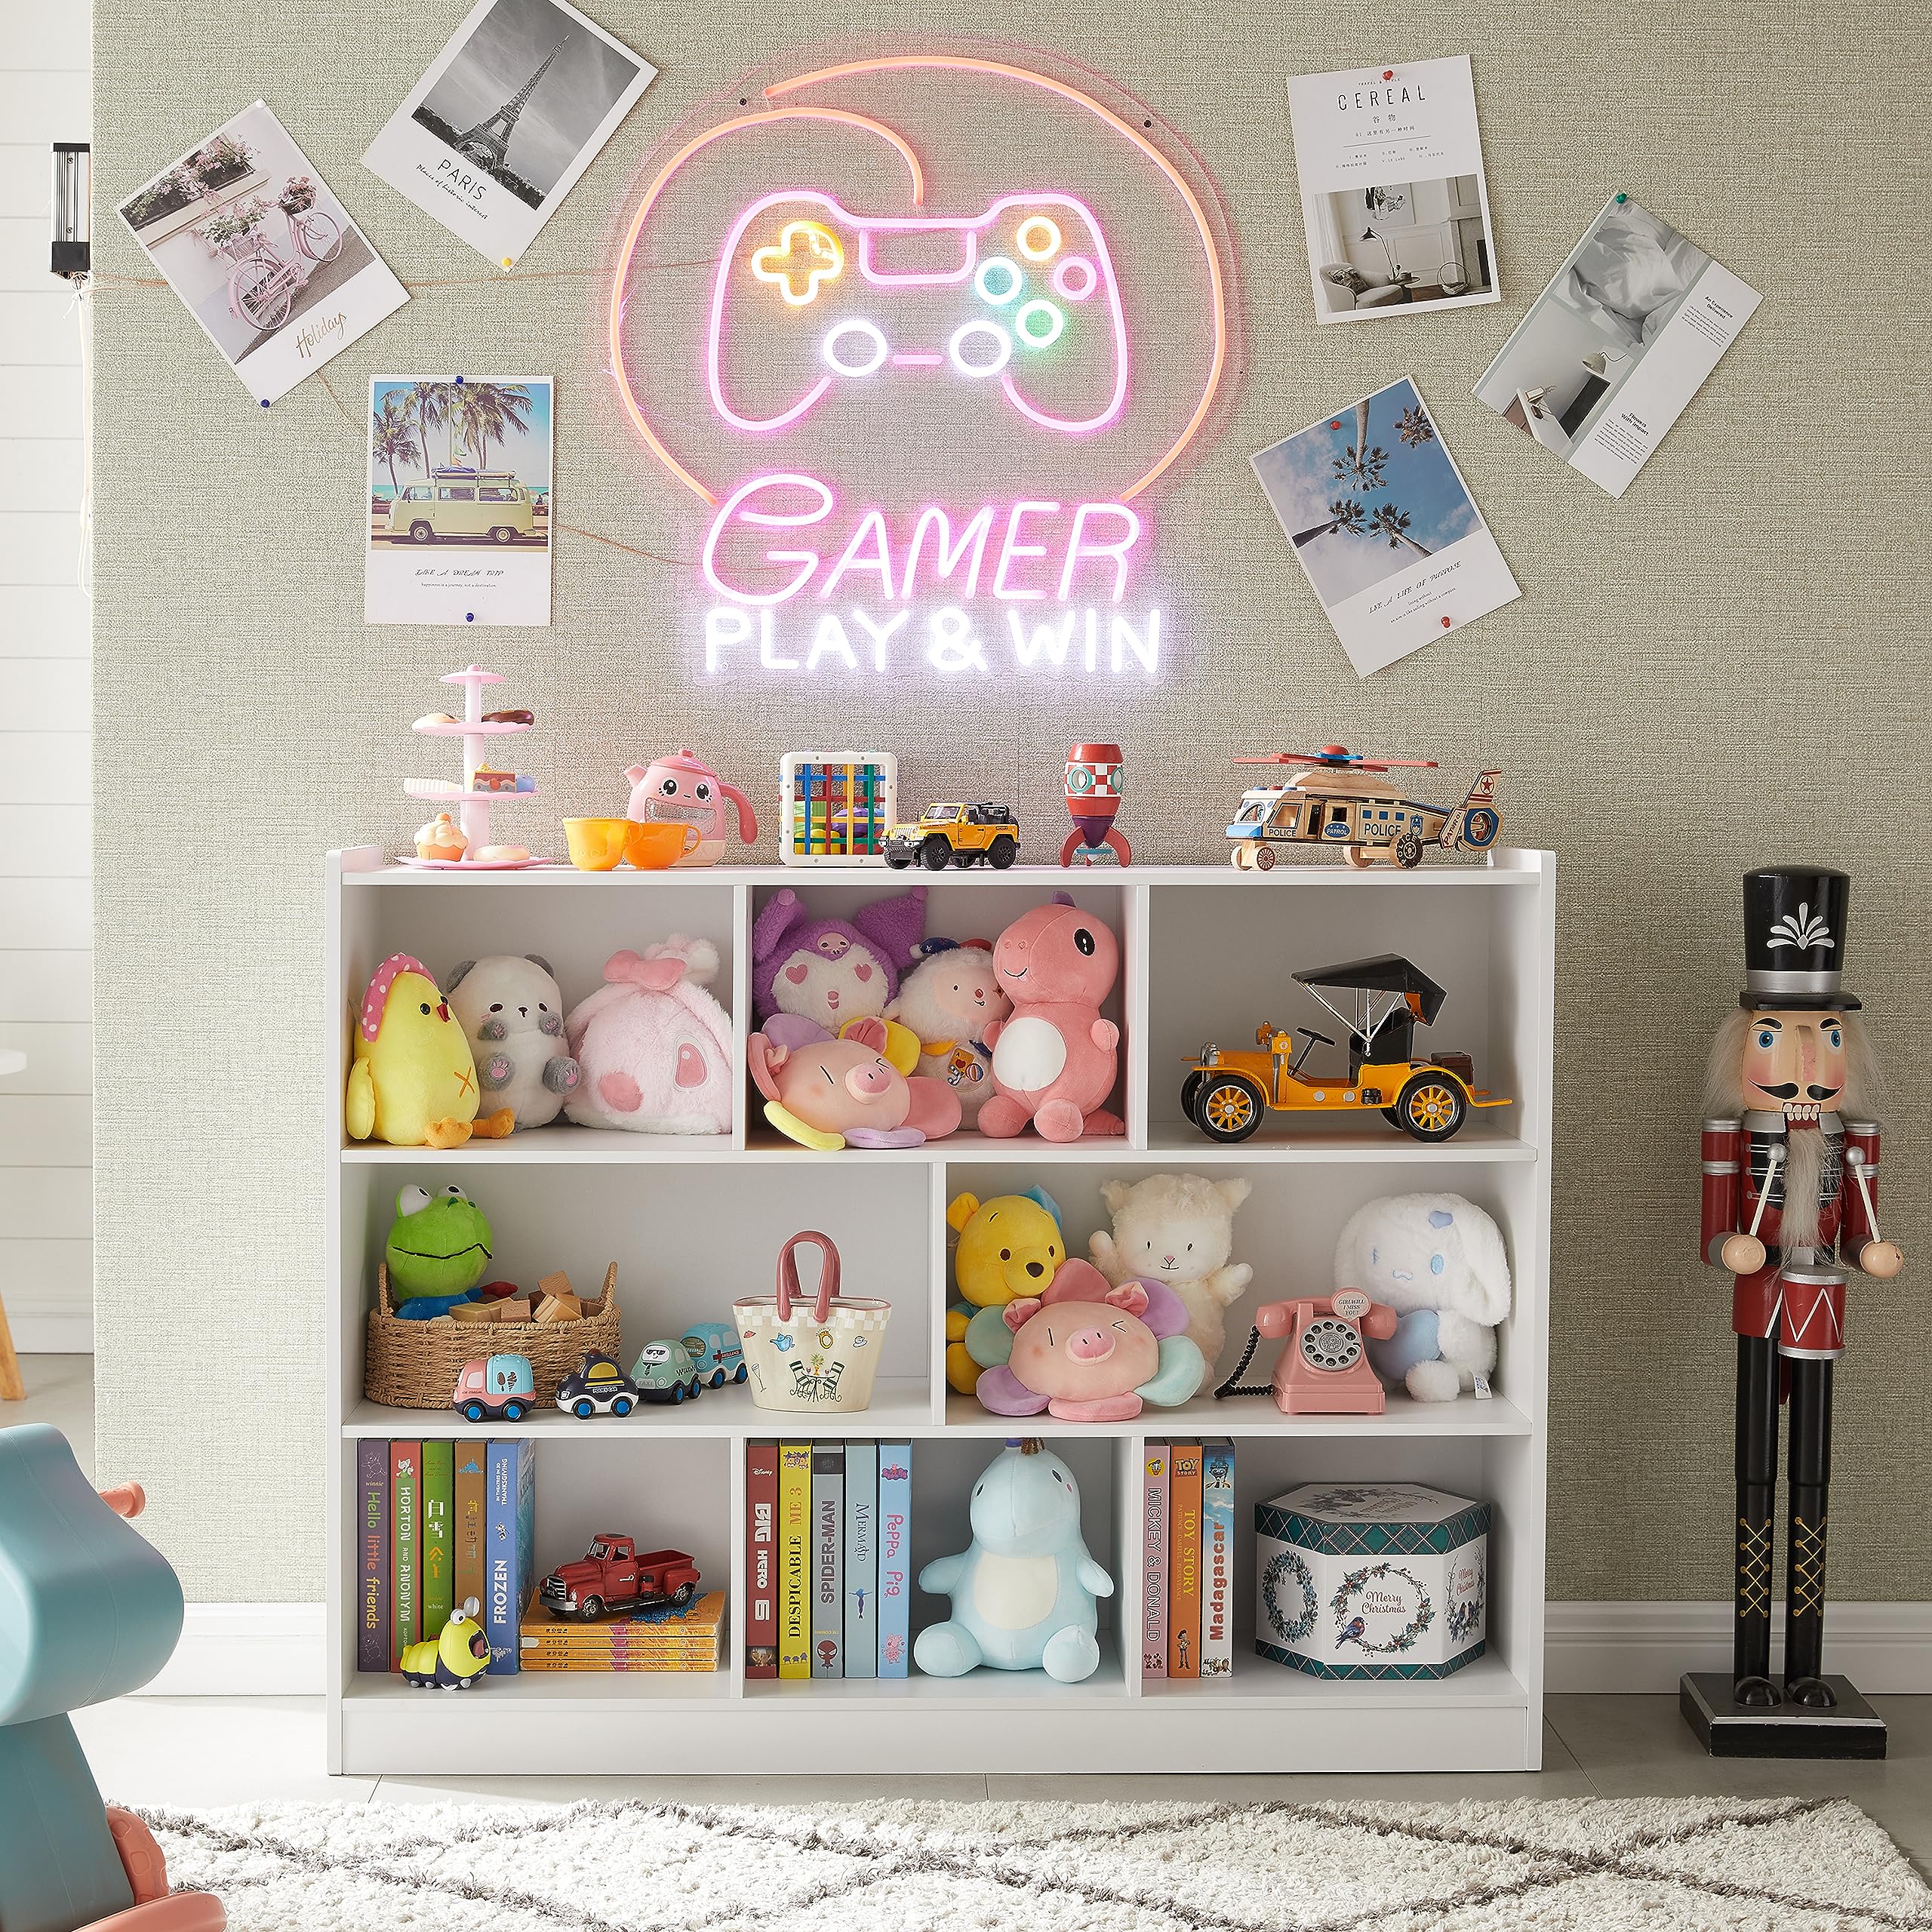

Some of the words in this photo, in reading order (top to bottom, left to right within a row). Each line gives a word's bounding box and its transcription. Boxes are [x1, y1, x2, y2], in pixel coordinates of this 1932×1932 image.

[1337, 85, 1426, 111] CEREAL
[437, 158, 487, 200] PARIS
[295, 312, 347, 358] Holidays
[702, 472, 1141, 605] GAMER
[1396, 586, 1413, 600] LIFE
[1416, 578, 1427, 590] OF
[705, 606, 909, 673] PLAY
[929, 606, 989, 673] &
[1008, 607, 1161, 674] WIN
[1269, 829, 1297, 837] POLICE
[1364, 823, 1401, 837] POLICE
[1444, 811, 1463, 845] PATROL
[1398, 834, 1417, 865] POLICE
[1174, 1457, 1200, 1472] TOY
[368, 1491, 381, 1529] Hello
[789, 1487, 802, 1496] 3
[400, 1486, 411, 1542] HORTON
[754, 1503, 772, 1543] BIG
[789, 1501, 802, 1526] ME
[1146, 1487, 1162, 1553] MICKEY
[1184, 1509, 1195, 1540] TOY
[367, 1535, 381, 1571] little
[820, 1500, 836, 1604] SPIDER-MAN
[886, 1513, 905, 1559] Peppa
[756, 1549, 768, 1589] HERO
[1146, 1555, 1162, 1568] &
[1183, 1547, 1195, 1596] STORY
[1208, 1521, 1229, 1641] Madagascar
[366, 1577, 381, 1630] friends
[493, 1559, 509, 1624] FROZEN
[787, 1535, 802, 1639] DESPICABLE
[883, 1571, 904, 1598] Pig
[1365, 1591, 1403, 1607] Merry
[1146, 1571, 1161, 1642] DONALD
[1361, 1601, 1407, 1615] Christmas
